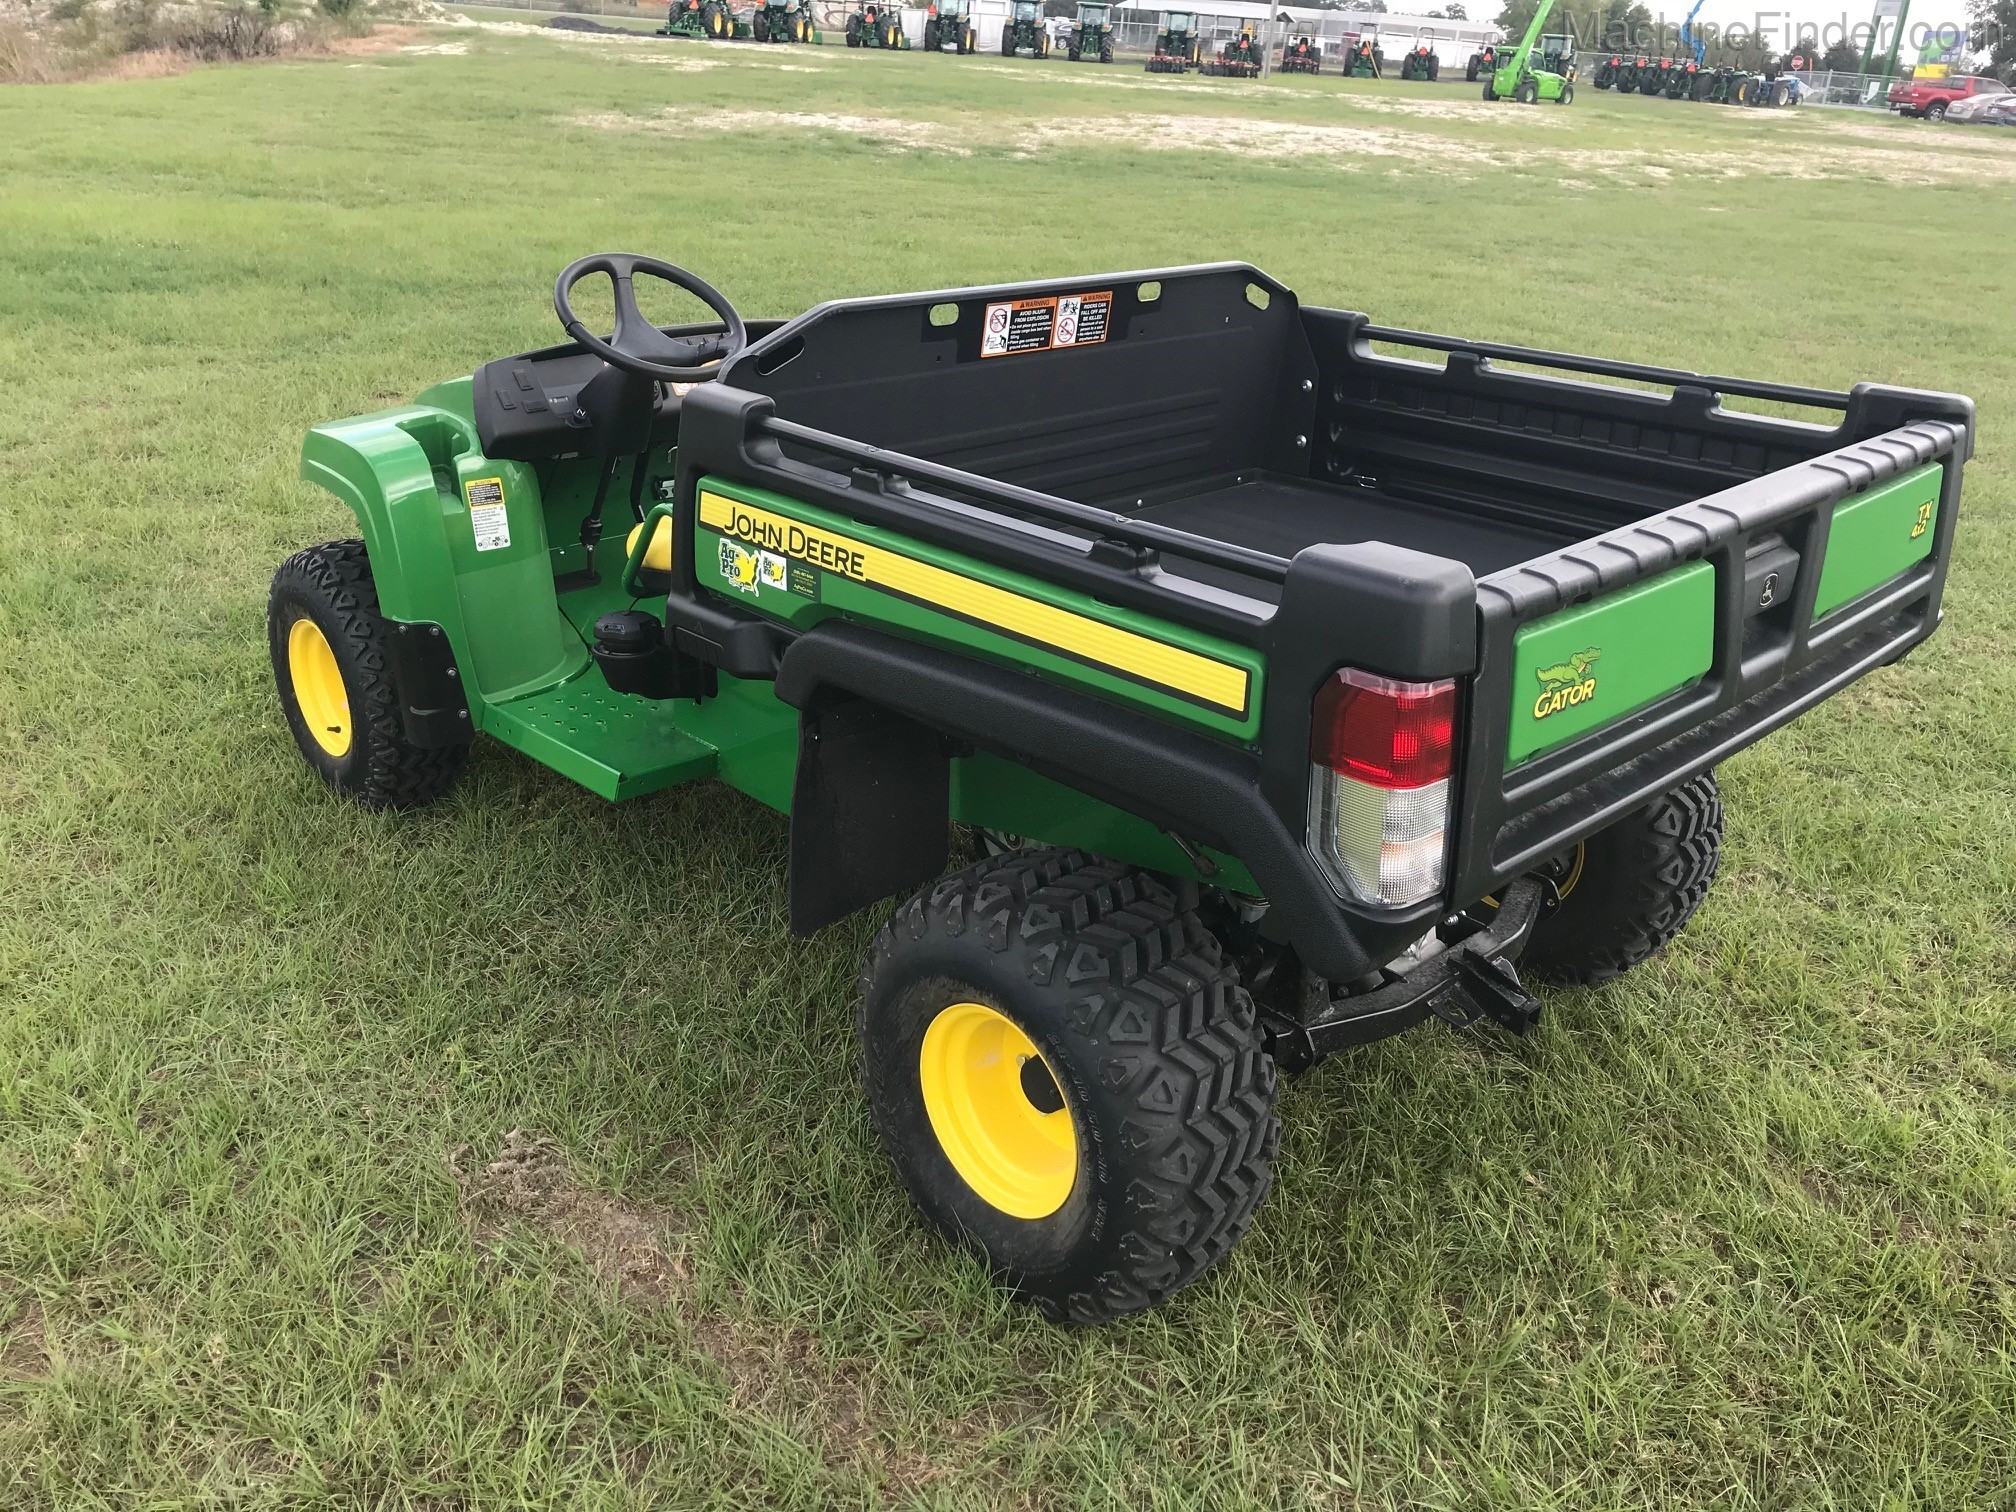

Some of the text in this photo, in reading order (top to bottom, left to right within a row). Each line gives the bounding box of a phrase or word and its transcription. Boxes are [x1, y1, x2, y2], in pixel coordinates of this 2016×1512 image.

[1919, 500, 1934, 524] TX
[724, 506, 865, 578] JOHN DEERE
[722, 560, 740, 577] Pro
[764, 565, 774, 576] Pro
[1533, 678, 1596, 718] GATOR
